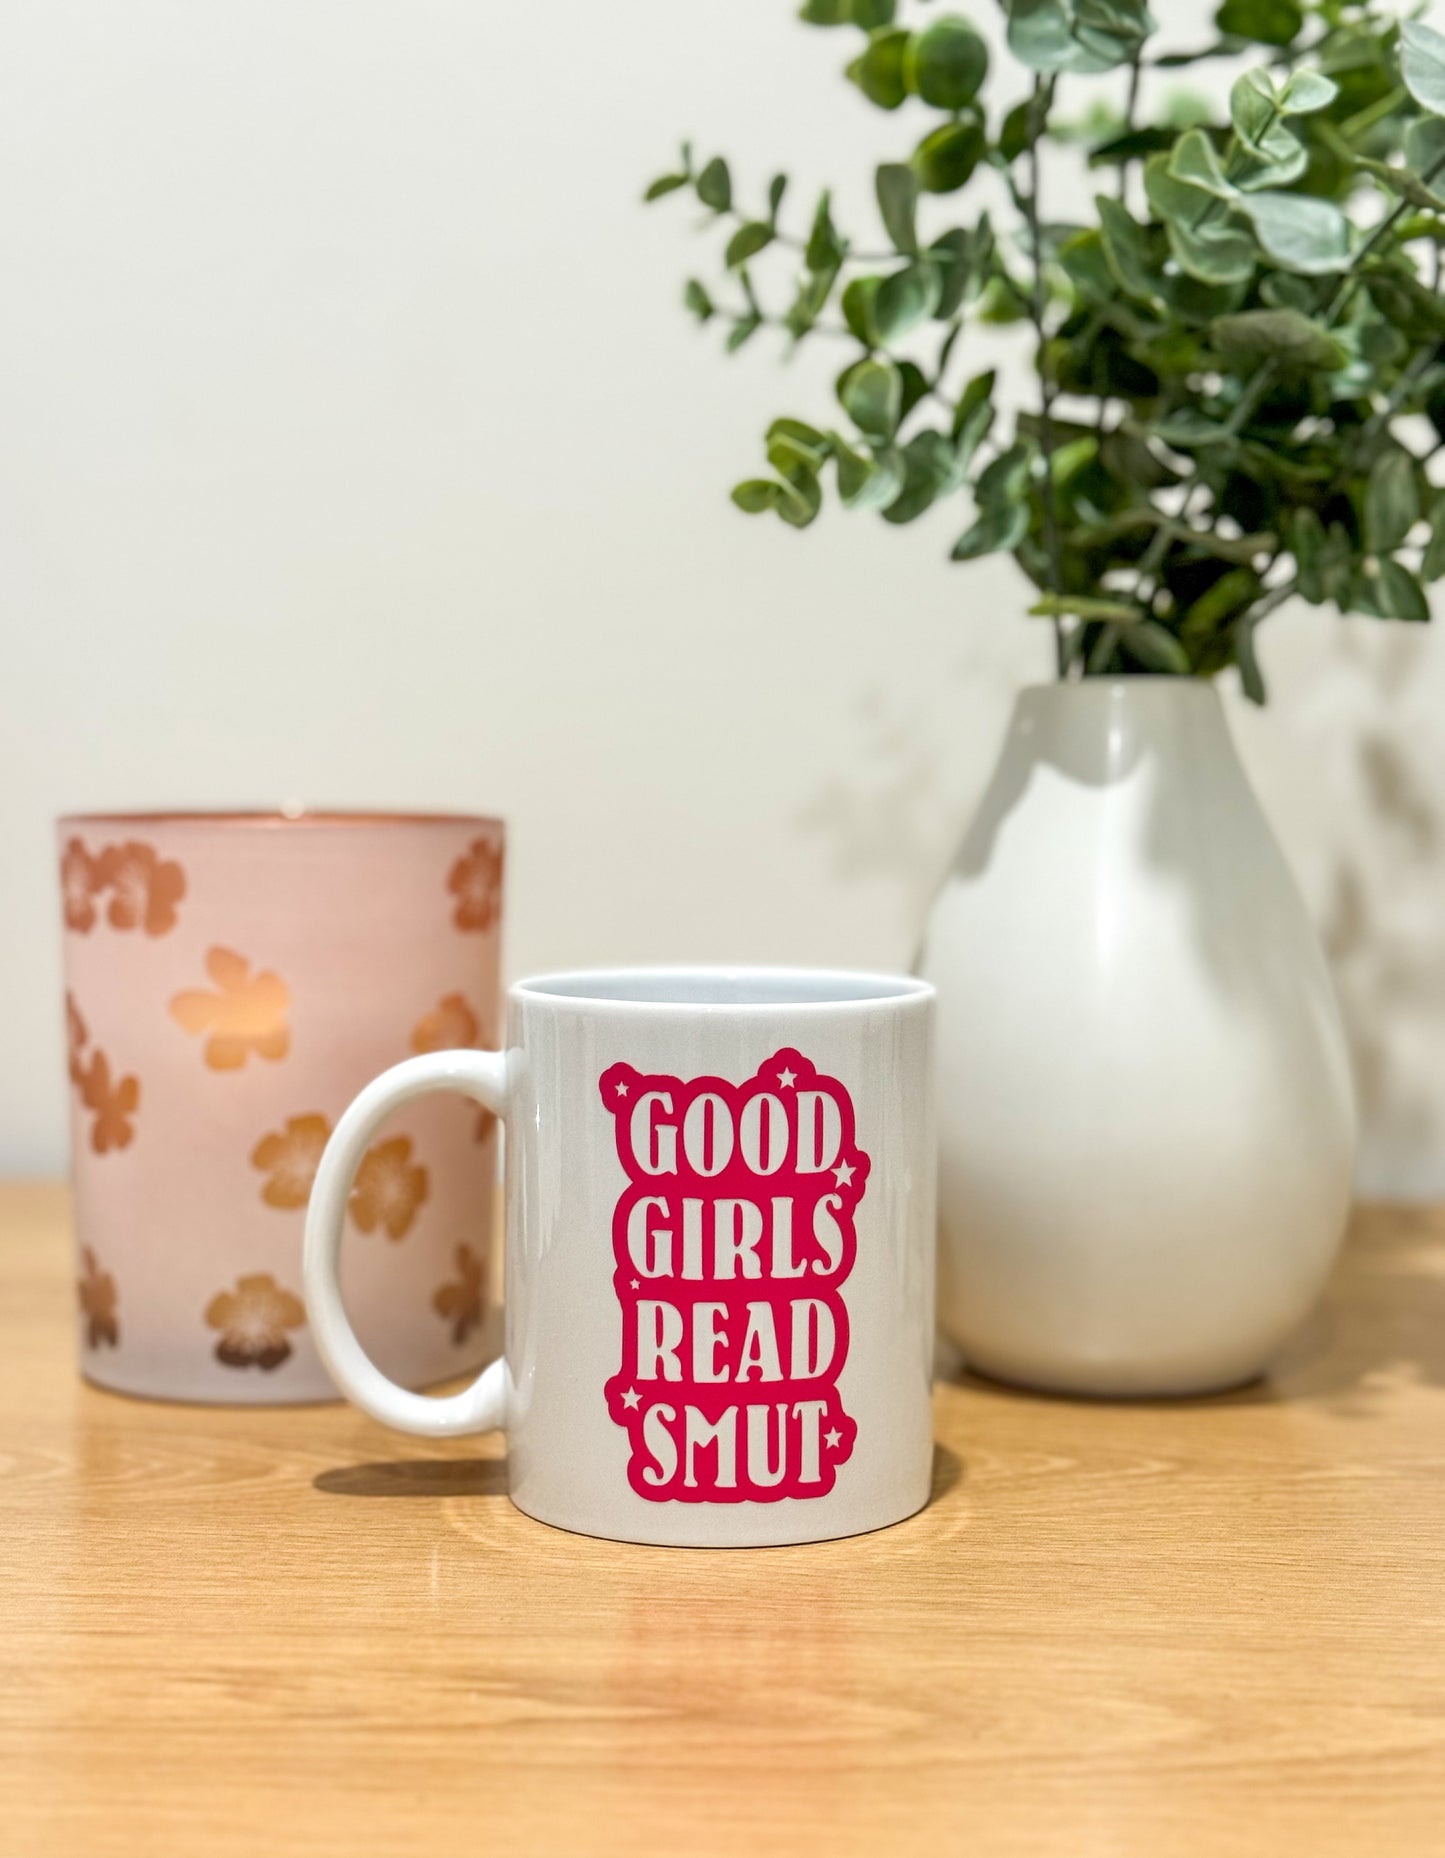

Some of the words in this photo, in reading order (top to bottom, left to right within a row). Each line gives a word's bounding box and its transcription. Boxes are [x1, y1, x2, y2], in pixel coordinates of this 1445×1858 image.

[630, 1090, 842, 1177] GOOD
[627, 1193, 844, 1280] GIRLS
[636, 1299, 836, 1383] READ
[642, 1400, 828, 1488] SMUT
